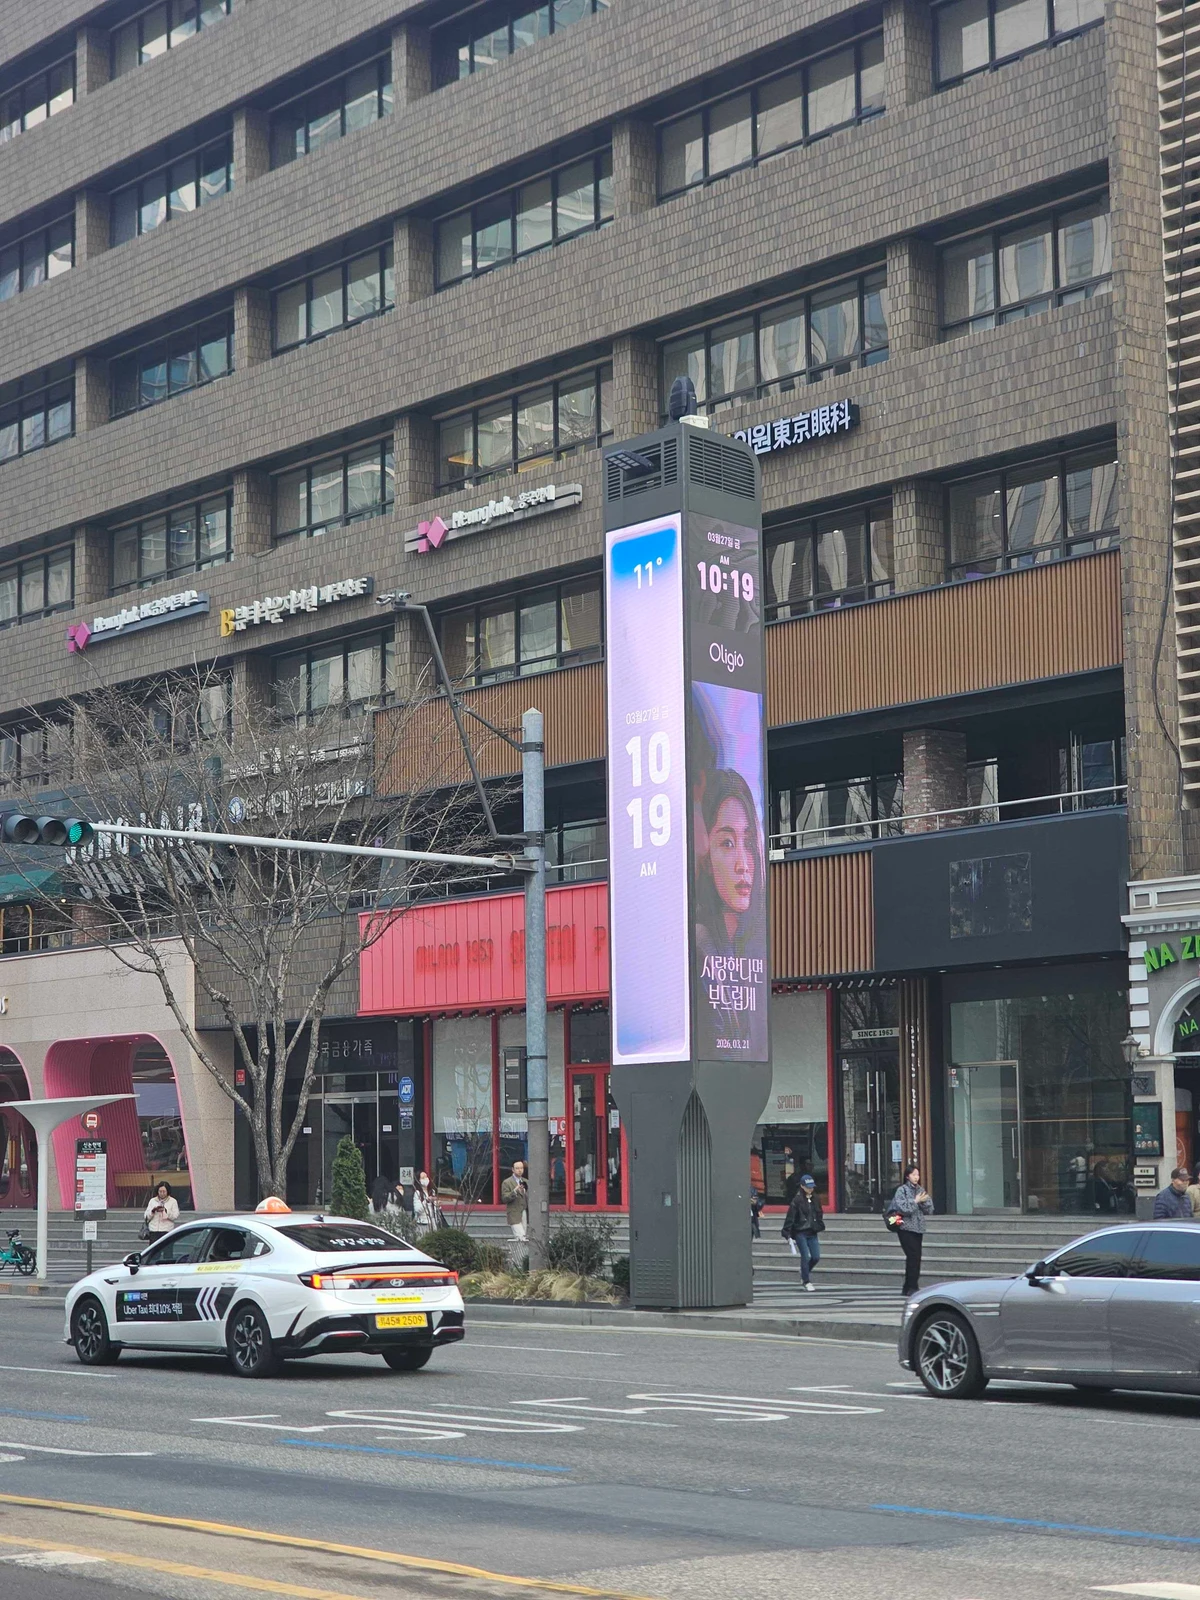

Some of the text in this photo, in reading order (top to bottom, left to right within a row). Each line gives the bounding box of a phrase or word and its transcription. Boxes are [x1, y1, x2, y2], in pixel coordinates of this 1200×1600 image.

[707, 531, 741, 550] 03월27일 금
[719, 554, 730, 565] AM
[696, 561, 754, 602] 10:19
[709, 642, 744, 673] Oligio
[625, 705, 670, 725] 03월27일 금
[625, 731, 671, 788] 10
[626, 793, 672, 850] 19
[639, 860, 657, 877] AM
[1144, 942, 1176, 973] NA
[700, 955, 763, 984] 사랑한다면
[708, 984, 756, 1011] 부드럽게
[857, 1029, 894, 1038] SINCE 1963
[1179, 1018, 1199, 1037] NA
[317, 1039, 373, 1058] 국금융가족
[401, 1085, 412, 1095] ADT
[123, 1305, 138, 1315] Uber
[402, 1314, 423, 1326] 2509
